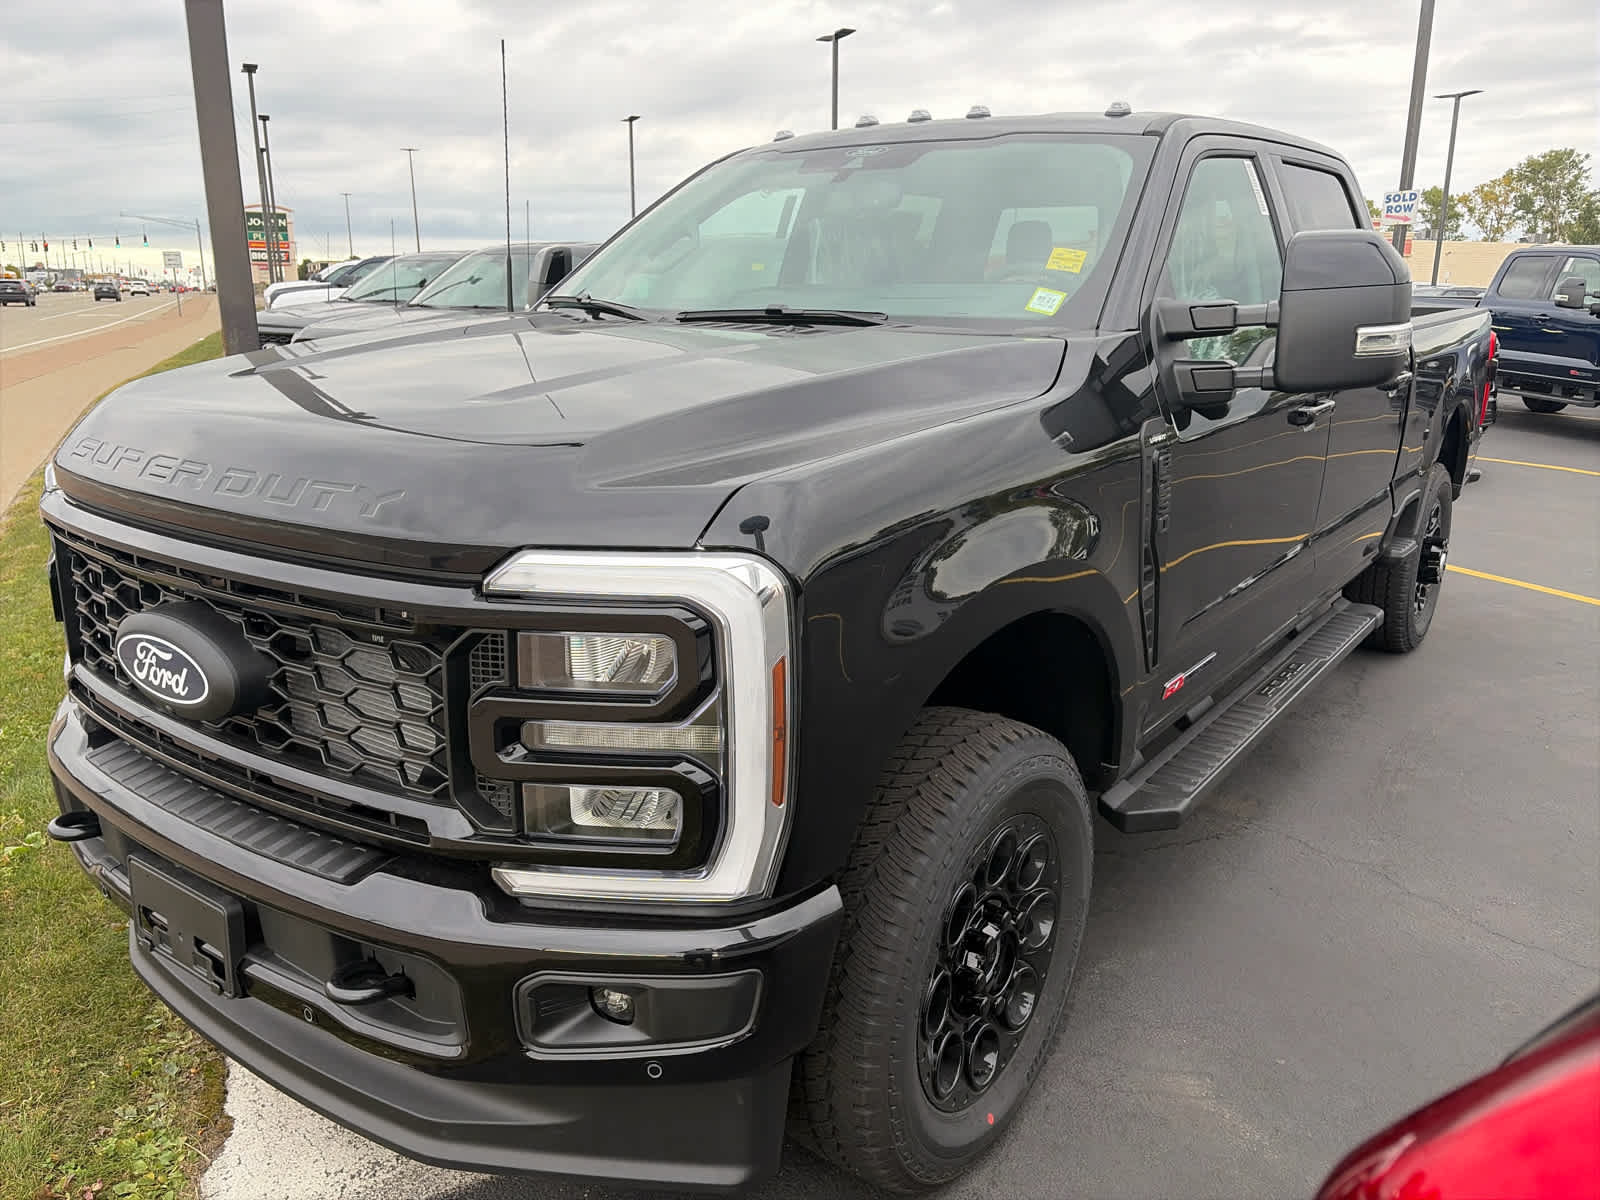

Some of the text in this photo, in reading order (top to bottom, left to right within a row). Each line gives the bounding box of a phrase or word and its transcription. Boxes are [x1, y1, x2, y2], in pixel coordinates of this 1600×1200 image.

[1385, 192, 1417, 203] SOLD
[1386, 203, 1414, 213] ROW
[71, 436, 408, 518] SUPER DUTY
[133, 641, 189, 696] Ford
